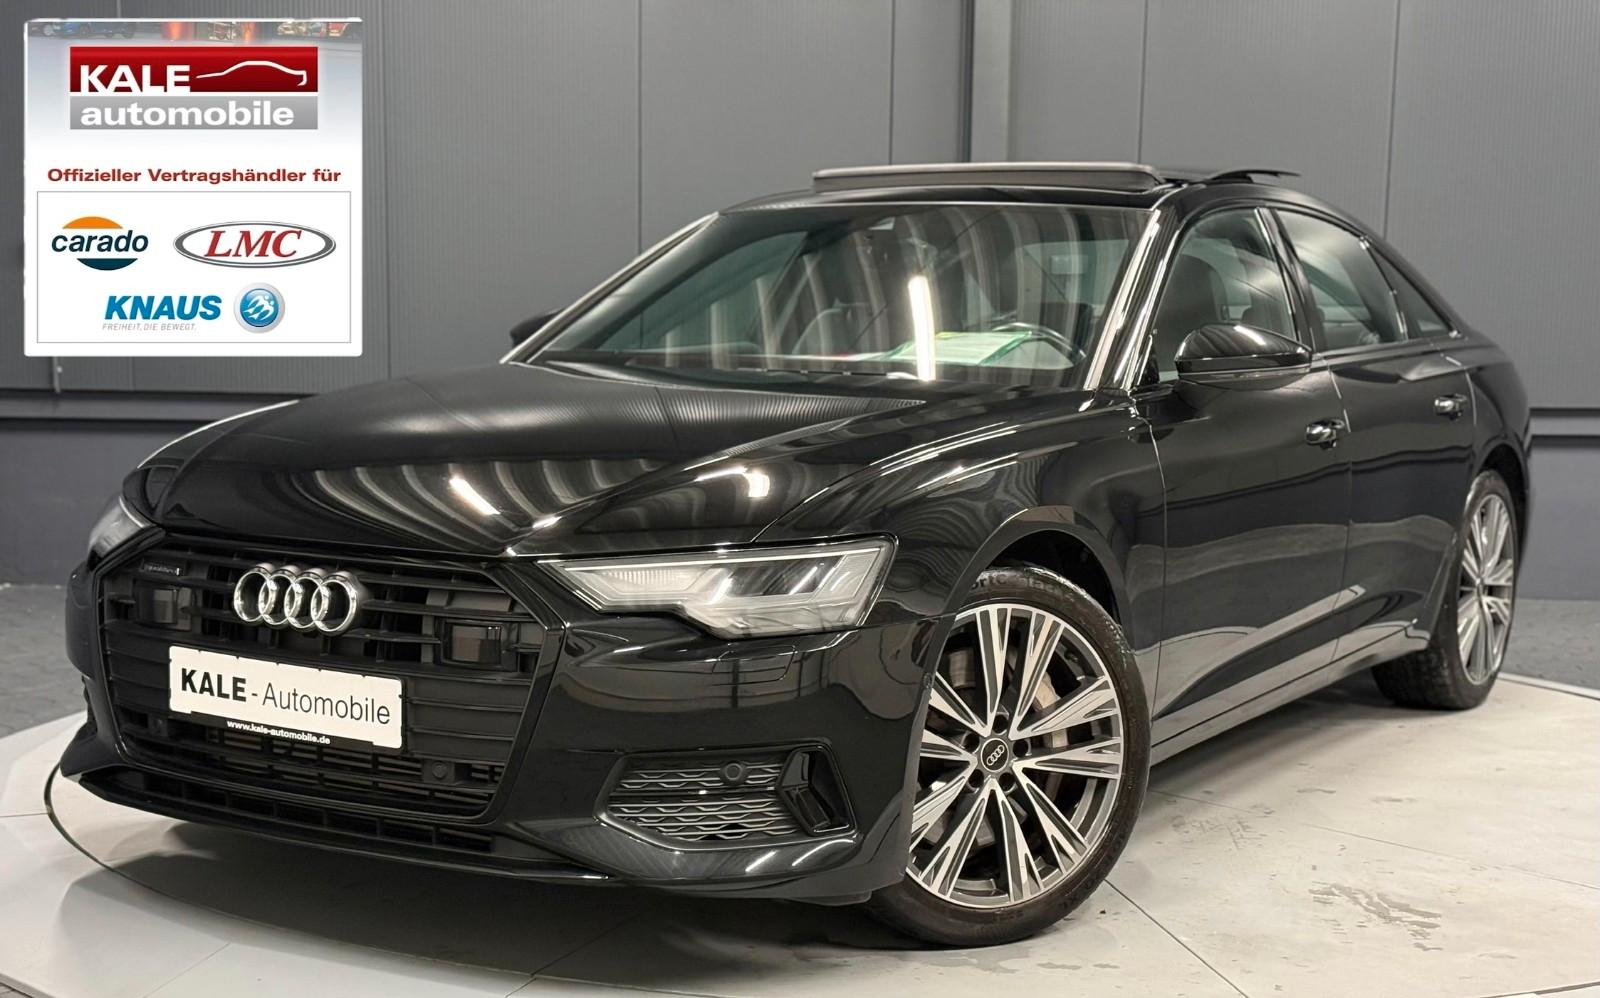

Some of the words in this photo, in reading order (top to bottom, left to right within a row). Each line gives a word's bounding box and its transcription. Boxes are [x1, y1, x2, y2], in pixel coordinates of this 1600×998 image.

[181, 667, 247, 702] KALE
[262, 682, 390, 725] Automobile
[227, 719, 331, 744] www.kale-automobile.de
